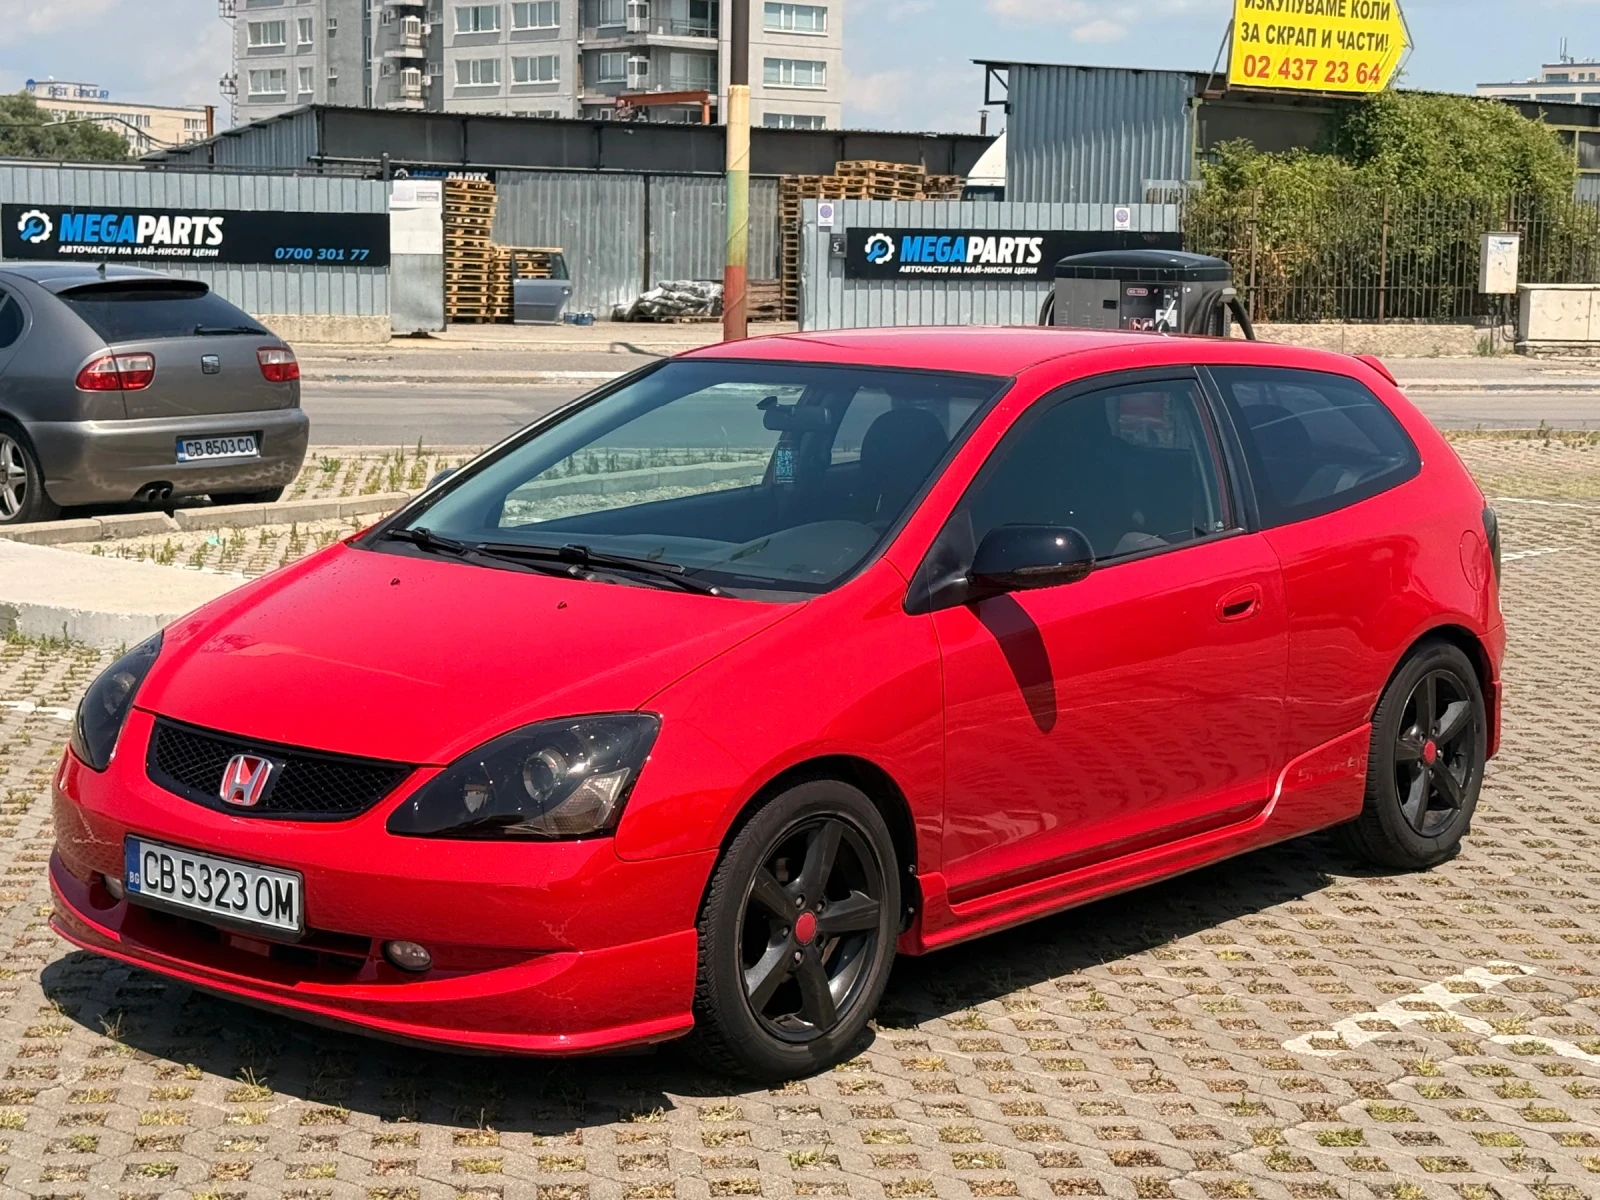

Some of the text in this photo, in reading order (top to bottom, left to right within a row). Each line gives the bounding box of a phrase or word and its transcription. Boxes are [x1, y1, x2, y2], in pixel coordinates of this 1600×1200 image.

[1351, 0, 1390, 21] КОЛИ
[1241, 21, 1389, 52] ЗА СКРАП И ЧАСТИ!
[1243, 54, 1381, 85] 02 437 23 64
[59, 213, 225, 246] MEGAPARTS
[58, 245, 219, 257] АВТОЧАСТИ НА НАЙ-НИСКИ ЦЕНИ
[274, 247, 370, 261] 0700 301 77
[832, 242, 841, 252] 5
[900, 235, 1044, 264] MEGAPARTS
[898, 264, 1038, 275] АВТОЧАСТИ НА НАЙ-НИСКИ ЦЕНИ
[186, 438, 253, 456] CB 8503 CO
[129, 871, 140, 884] BG
[144, 851, 294, 923] CB 5323 OM
